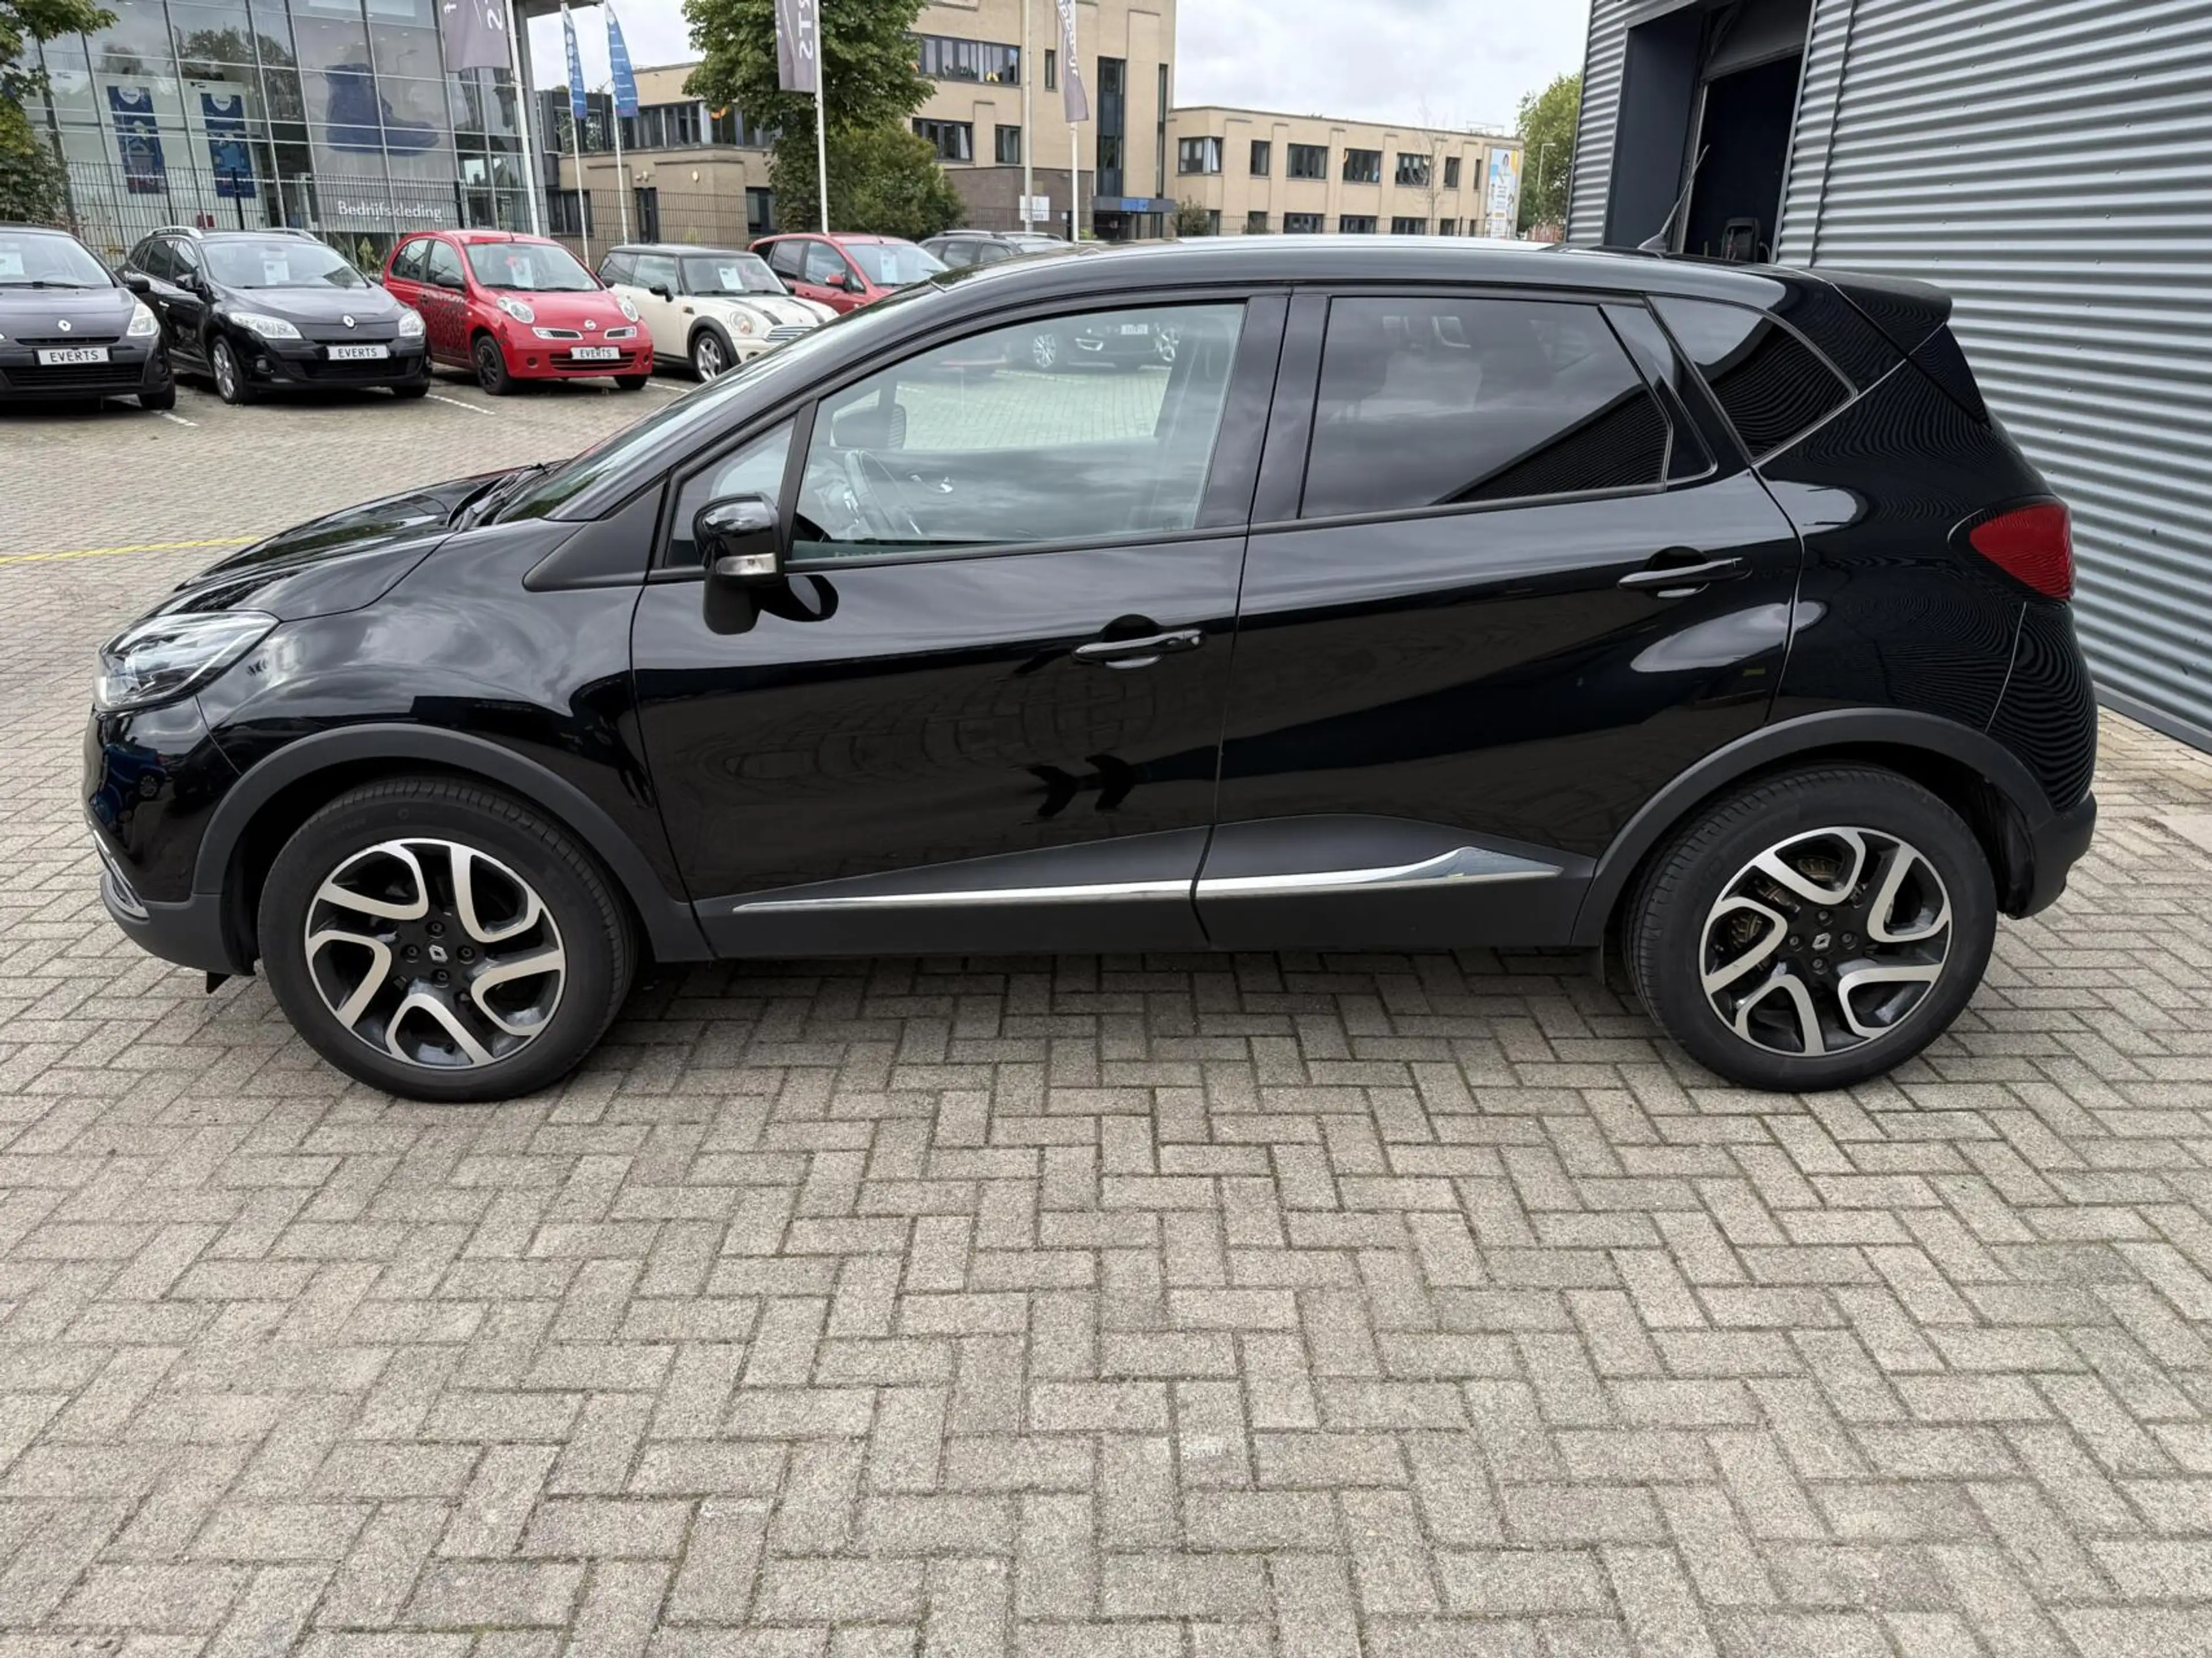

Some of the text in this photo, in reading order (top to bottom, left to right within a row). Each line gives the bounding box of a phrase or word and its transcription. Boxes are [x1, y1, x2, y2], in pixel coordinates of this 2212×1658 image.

[338, 200, 442, 222] Bedrijfskleding
[50, 350, 99, 362] EVERTS
[338, 347, 377, 358] EVERTS
[580, 348, 612, 358] EVERTS
